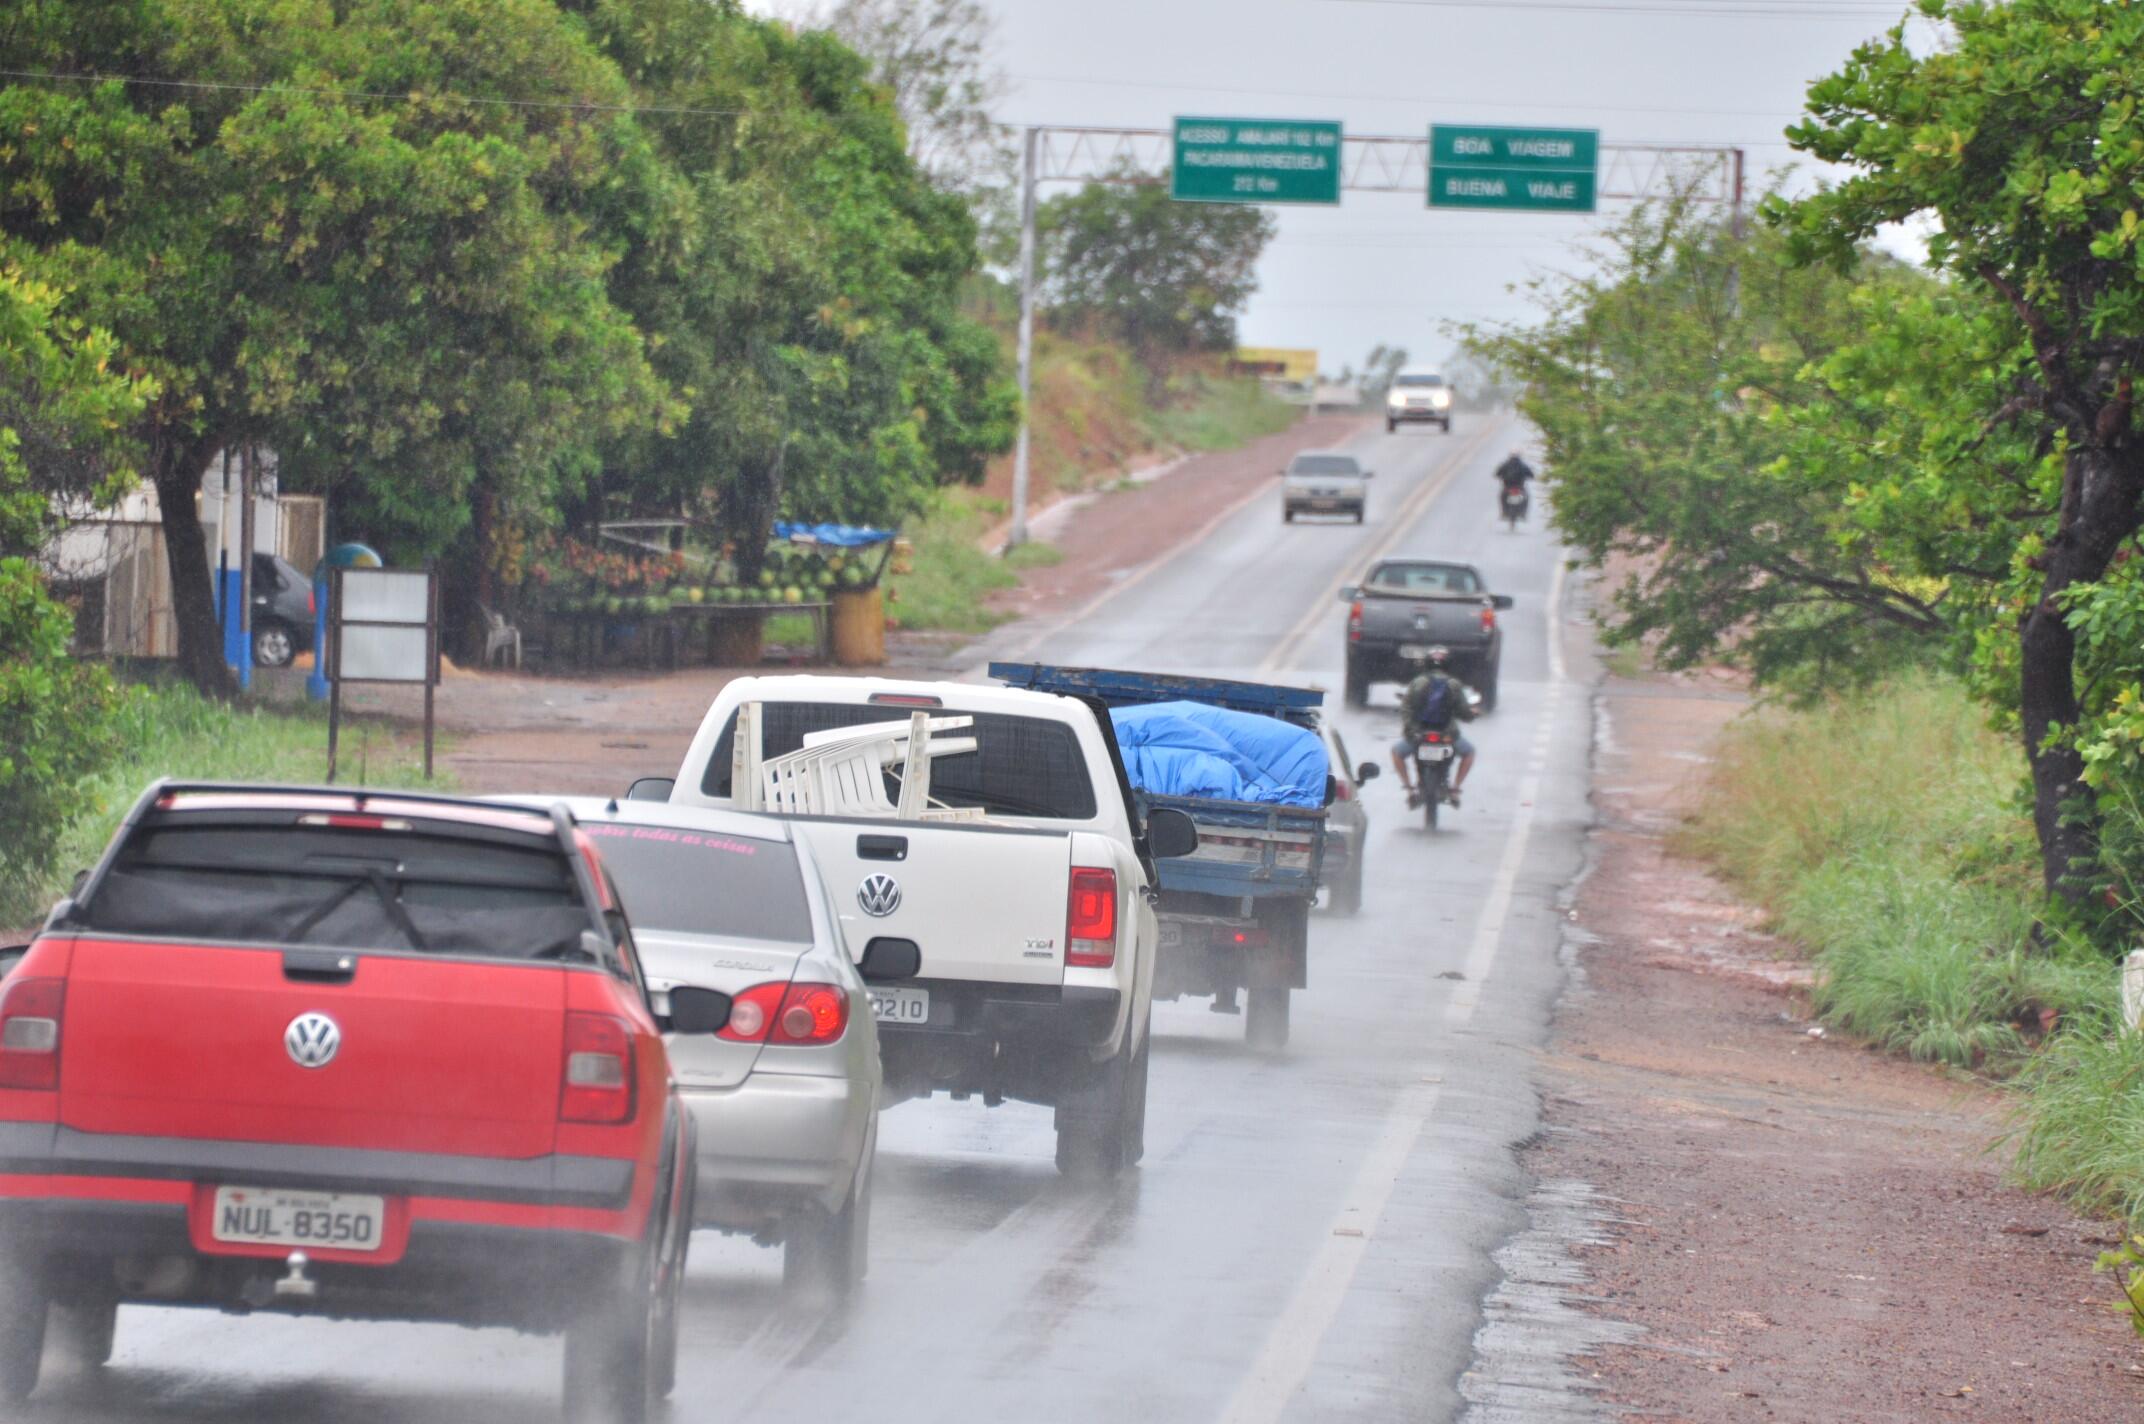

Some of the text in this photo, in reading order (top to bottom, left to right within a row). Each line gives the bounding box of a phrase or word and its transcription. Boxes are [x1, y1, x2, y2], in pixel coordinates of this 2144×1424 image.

[1452, 136, 1575, 158] BOA VIAGEM
[1446, 178, 1577, 199] BUENA VIAJE
[632, 827, 678, 843] todas
[704, 838, 757, 856] coisas
